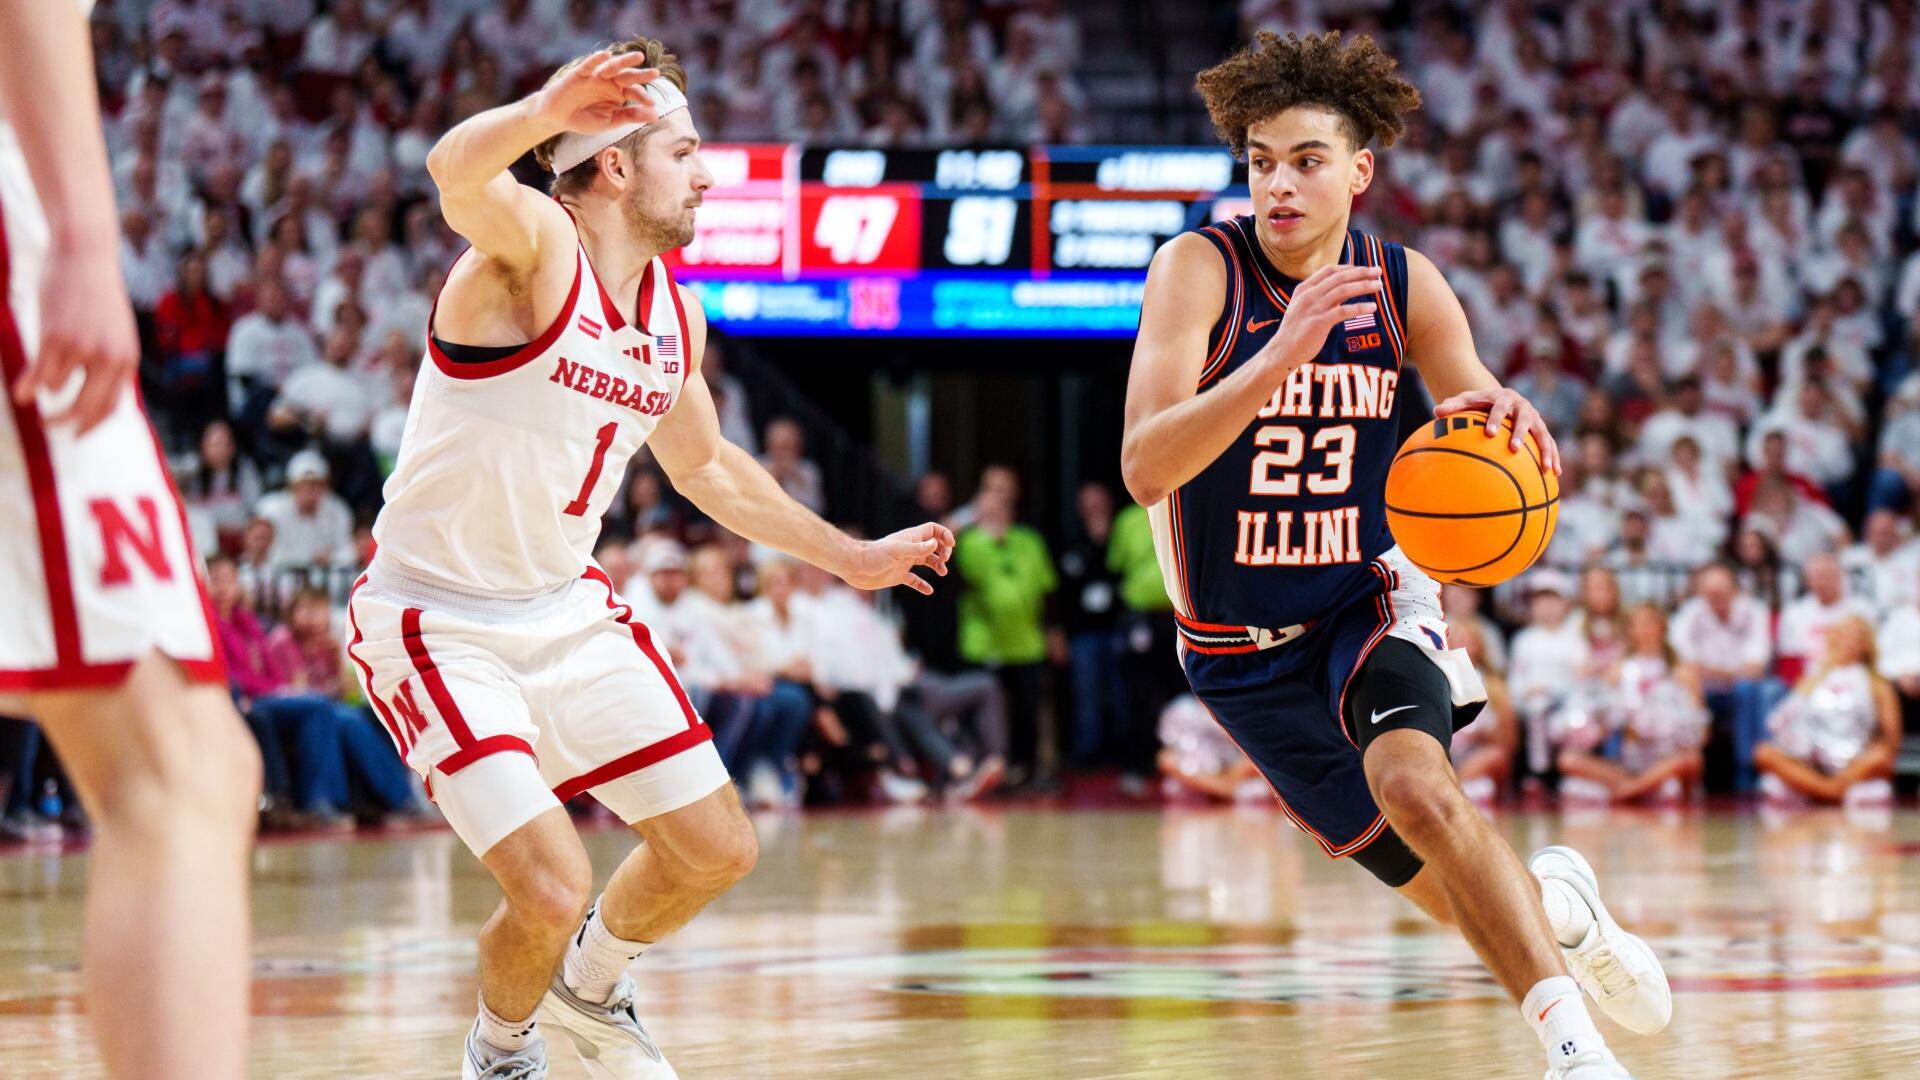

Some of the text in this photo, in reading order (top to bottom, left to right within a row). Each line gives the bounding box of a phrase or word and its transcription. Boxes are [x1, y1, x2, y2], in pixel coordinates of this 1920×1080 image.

[814, 196, 898, 263] 47
[563, 421, 618, 517] 1
[1250, 424, 1357, 496] 23
[88, 497, 173, 585] N
[1234, 506, 1362, 566] ILLINI
